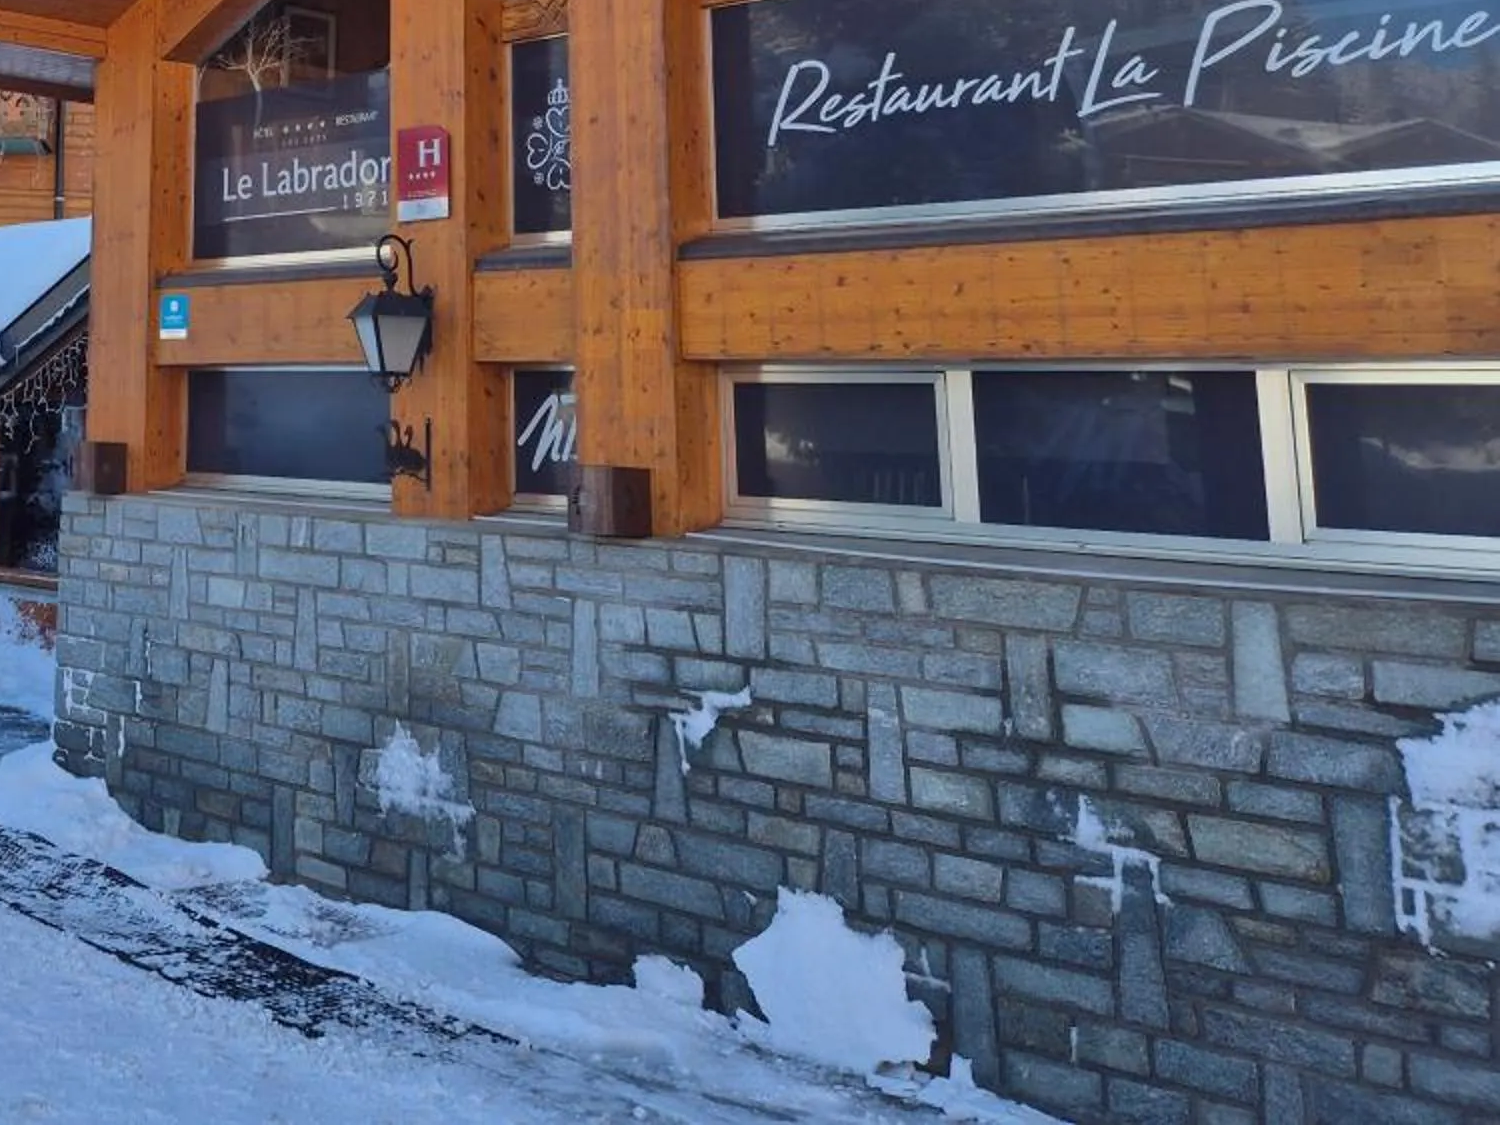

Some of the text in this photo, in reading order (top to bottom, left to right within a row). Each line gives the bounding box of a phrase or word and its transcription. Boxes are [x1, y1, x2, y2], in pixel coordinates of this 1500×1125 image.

[766, 26, 1084, 147] Restaurant
[1077, 18, 1163, 118] La
[418, 137, 442, 168] H
[222, 150, 392, 202] Le Labrador
[342, 190, 390, 210] 1971
